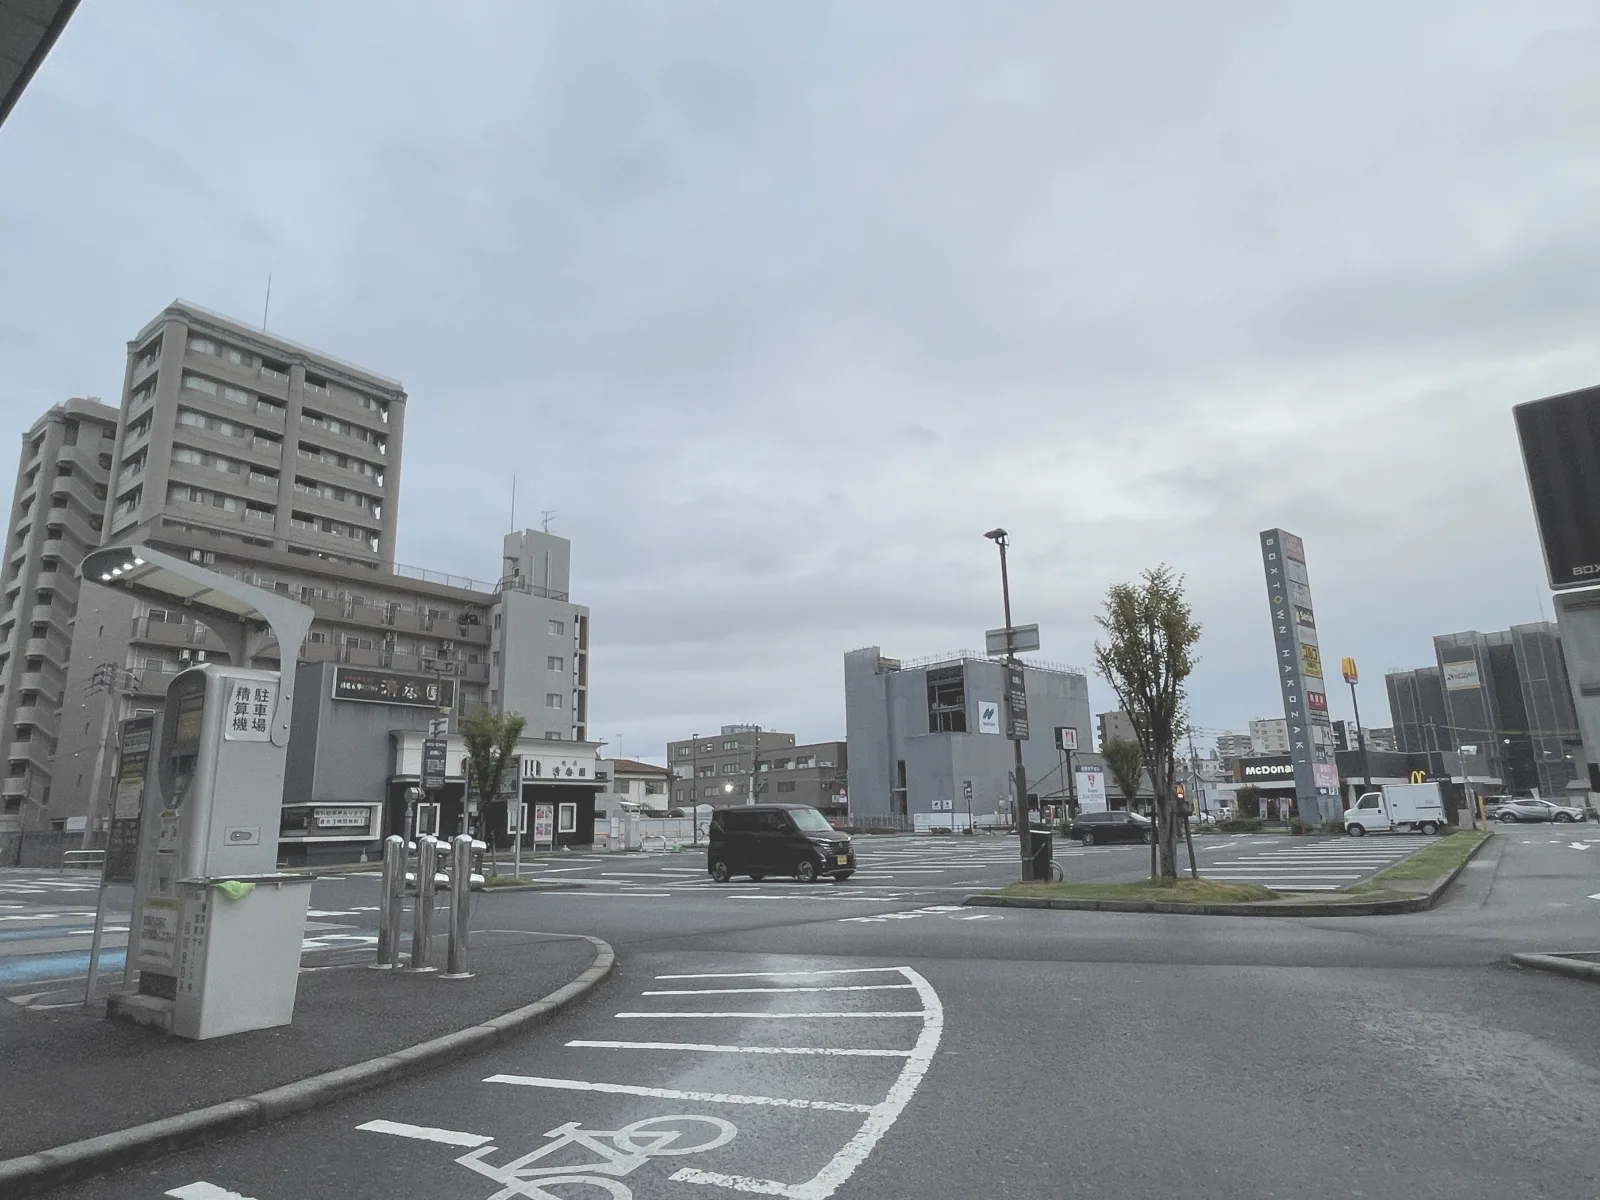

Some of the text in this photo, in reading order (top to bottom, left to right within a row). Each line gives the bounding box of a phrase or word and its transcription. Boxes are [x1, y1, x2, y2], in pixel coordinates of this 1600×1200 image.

[232, 686, 251, 732] 精算機
[252, 688, 270, 733] 駐車場
[1281, 649, 1306, 763] HAKOZAKI
